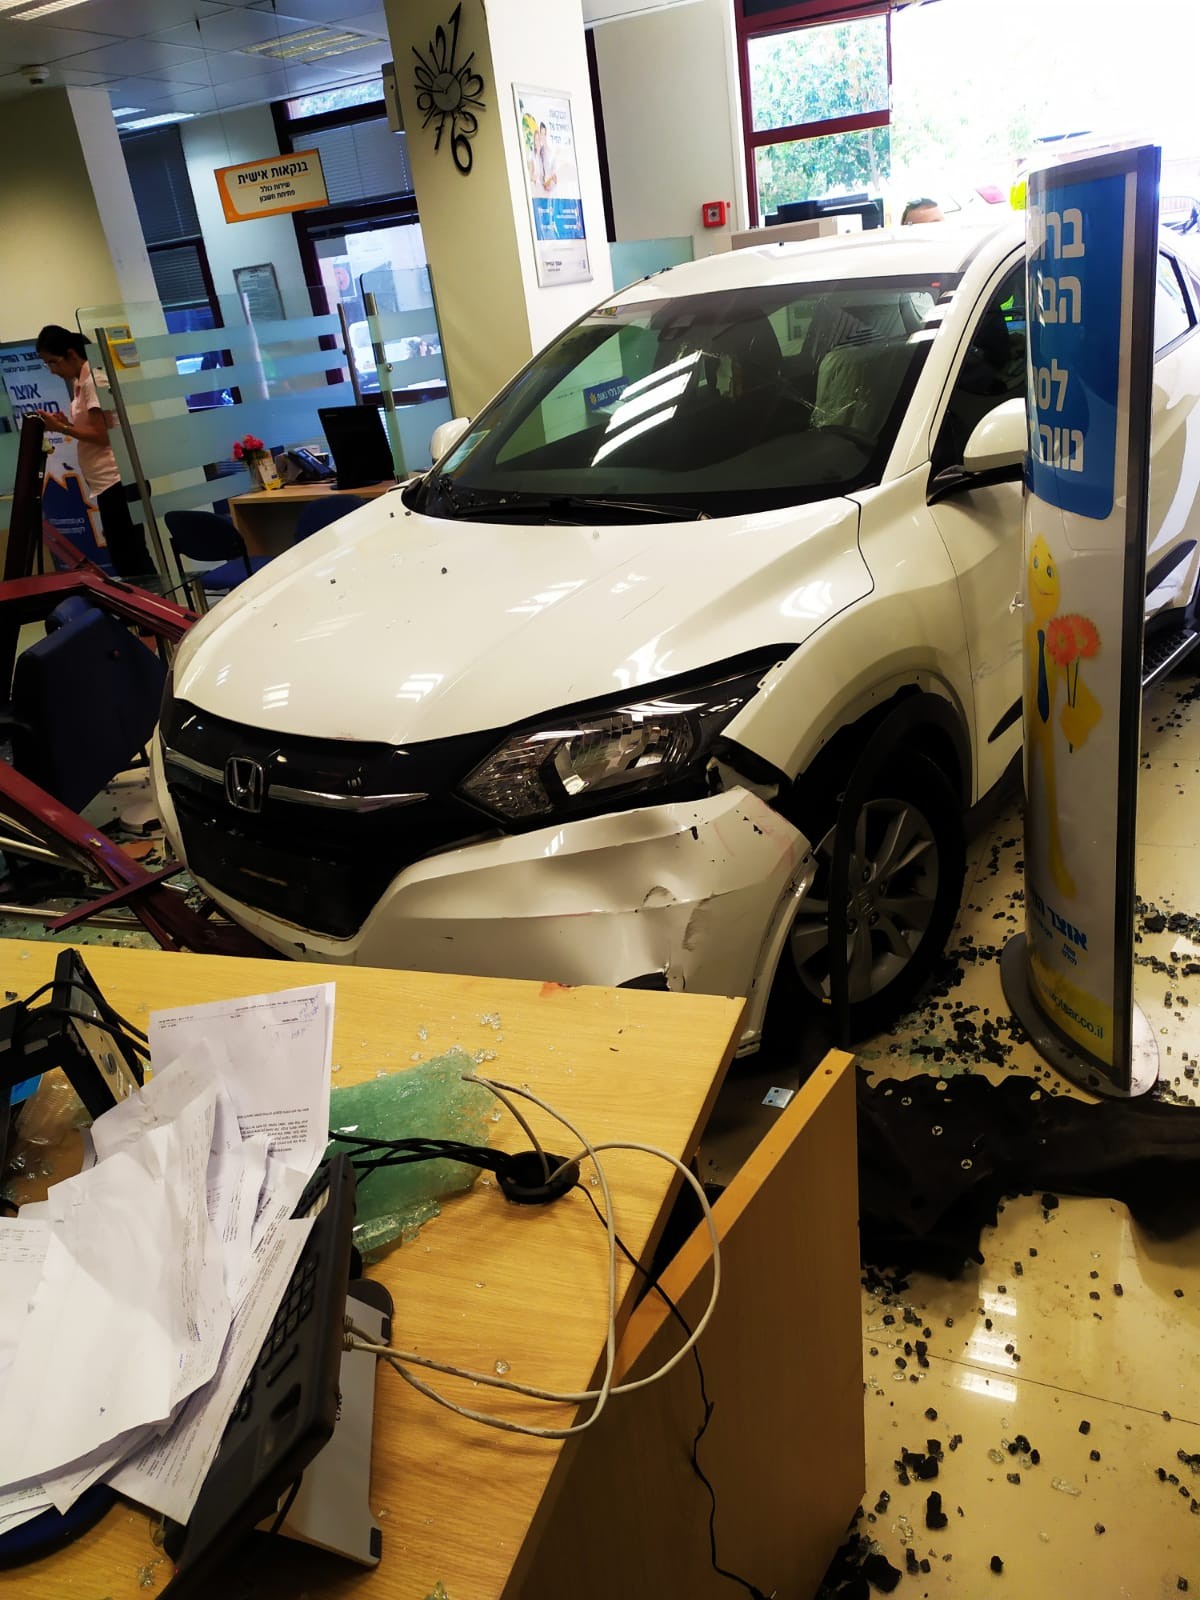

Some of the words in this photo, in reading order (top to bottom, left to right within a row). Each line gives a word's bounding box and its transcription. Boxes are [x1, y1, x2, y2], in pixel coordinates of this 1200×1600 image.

[238, 169, 268, 185] אישית
[271, 161, 309, 178] בנקאות
[1031, 275, 1081, 324] הבא
[10, 383, 41, 400] אוצר
